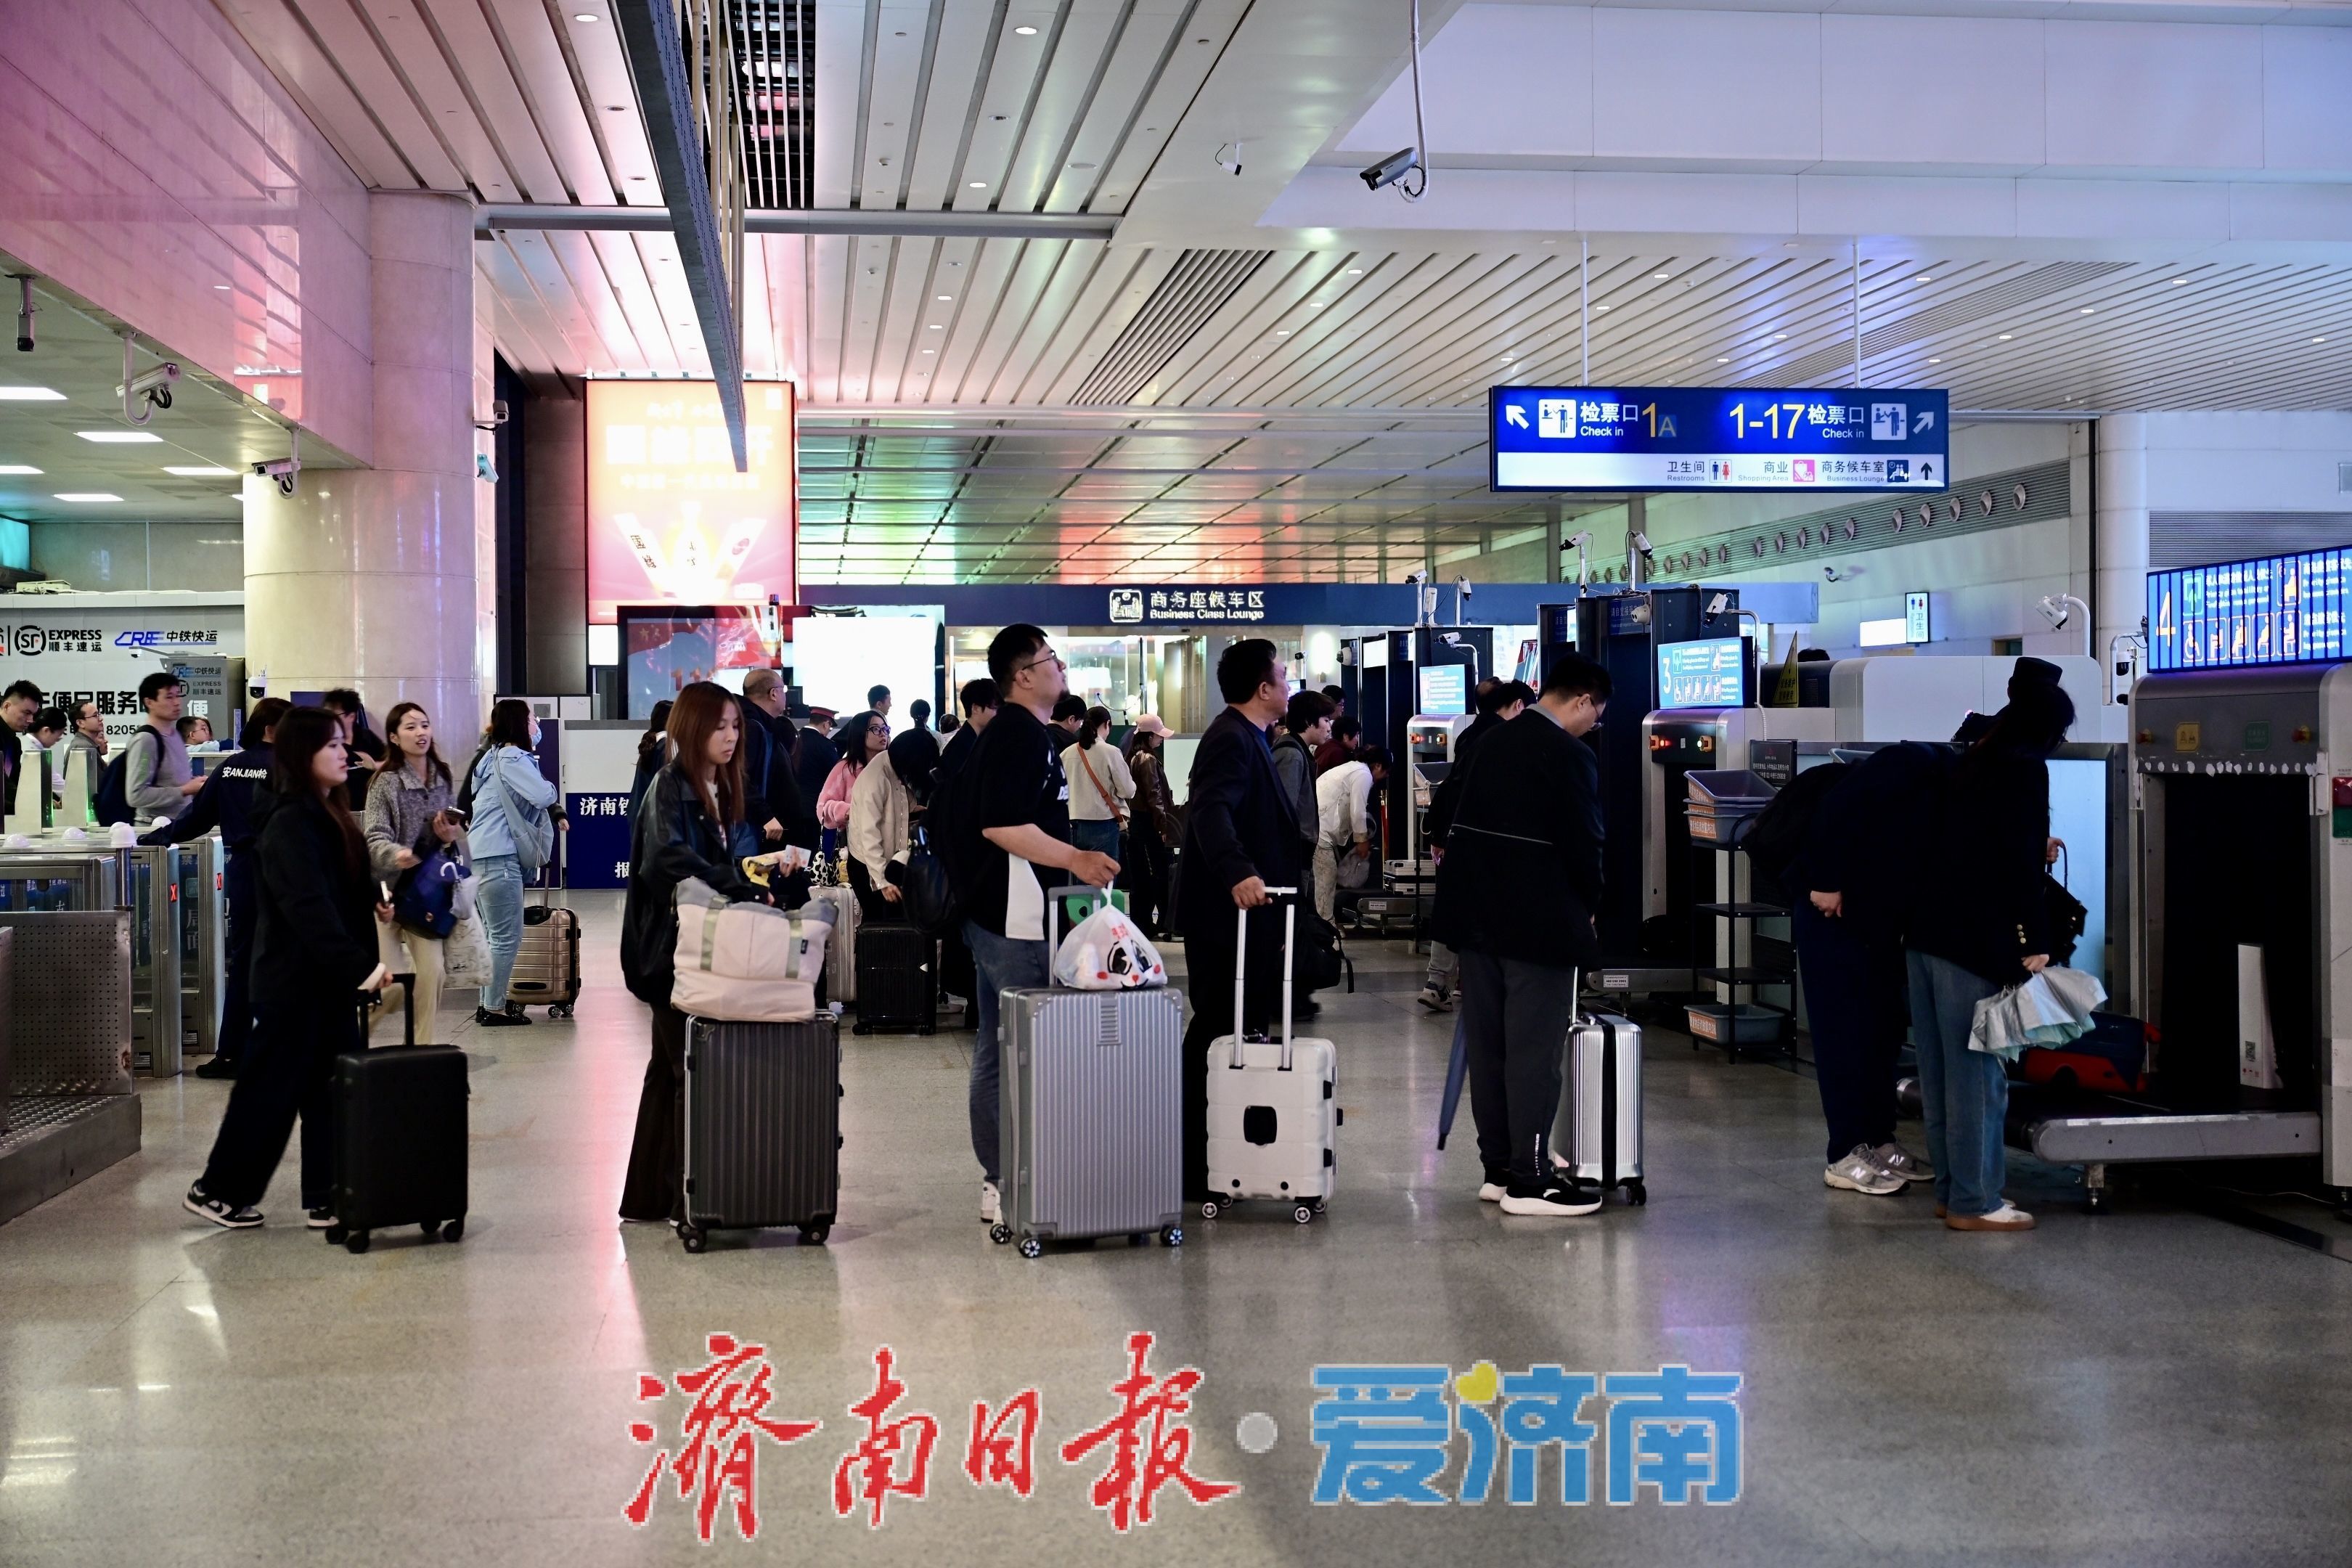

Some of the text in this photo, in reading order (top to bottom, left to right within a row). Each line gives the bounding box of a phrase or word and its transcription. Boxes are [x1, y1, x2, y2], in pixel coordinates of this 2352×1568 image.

[1580, 401, 1638, 422] 检票口
[1730, 403, 1864, 438] 1-17 检票口
[1580, 426, 1624, 436] Check in
[1822, 428, 1864, 438] Check in
[1667, 461, 1705, 473] 卫生间
[1763, 461, 1788, 473] 商业
[1821, 460, 1885, 473] 商务候车室
[1151, 591, 1265, 608] 商务座候车区
[1150, 609, 1265, 621] Business Class Lounge
[2156, 591, 2176, 647] 4
[49, 629, 102, 640] EXPRESS
[166, 630, 218, 642] 中铁快运
[49, 642, 102, 651] 顺丰速运
[1663, 657, 1671, 694] 3
[106, 724, 141, 735] 8205
